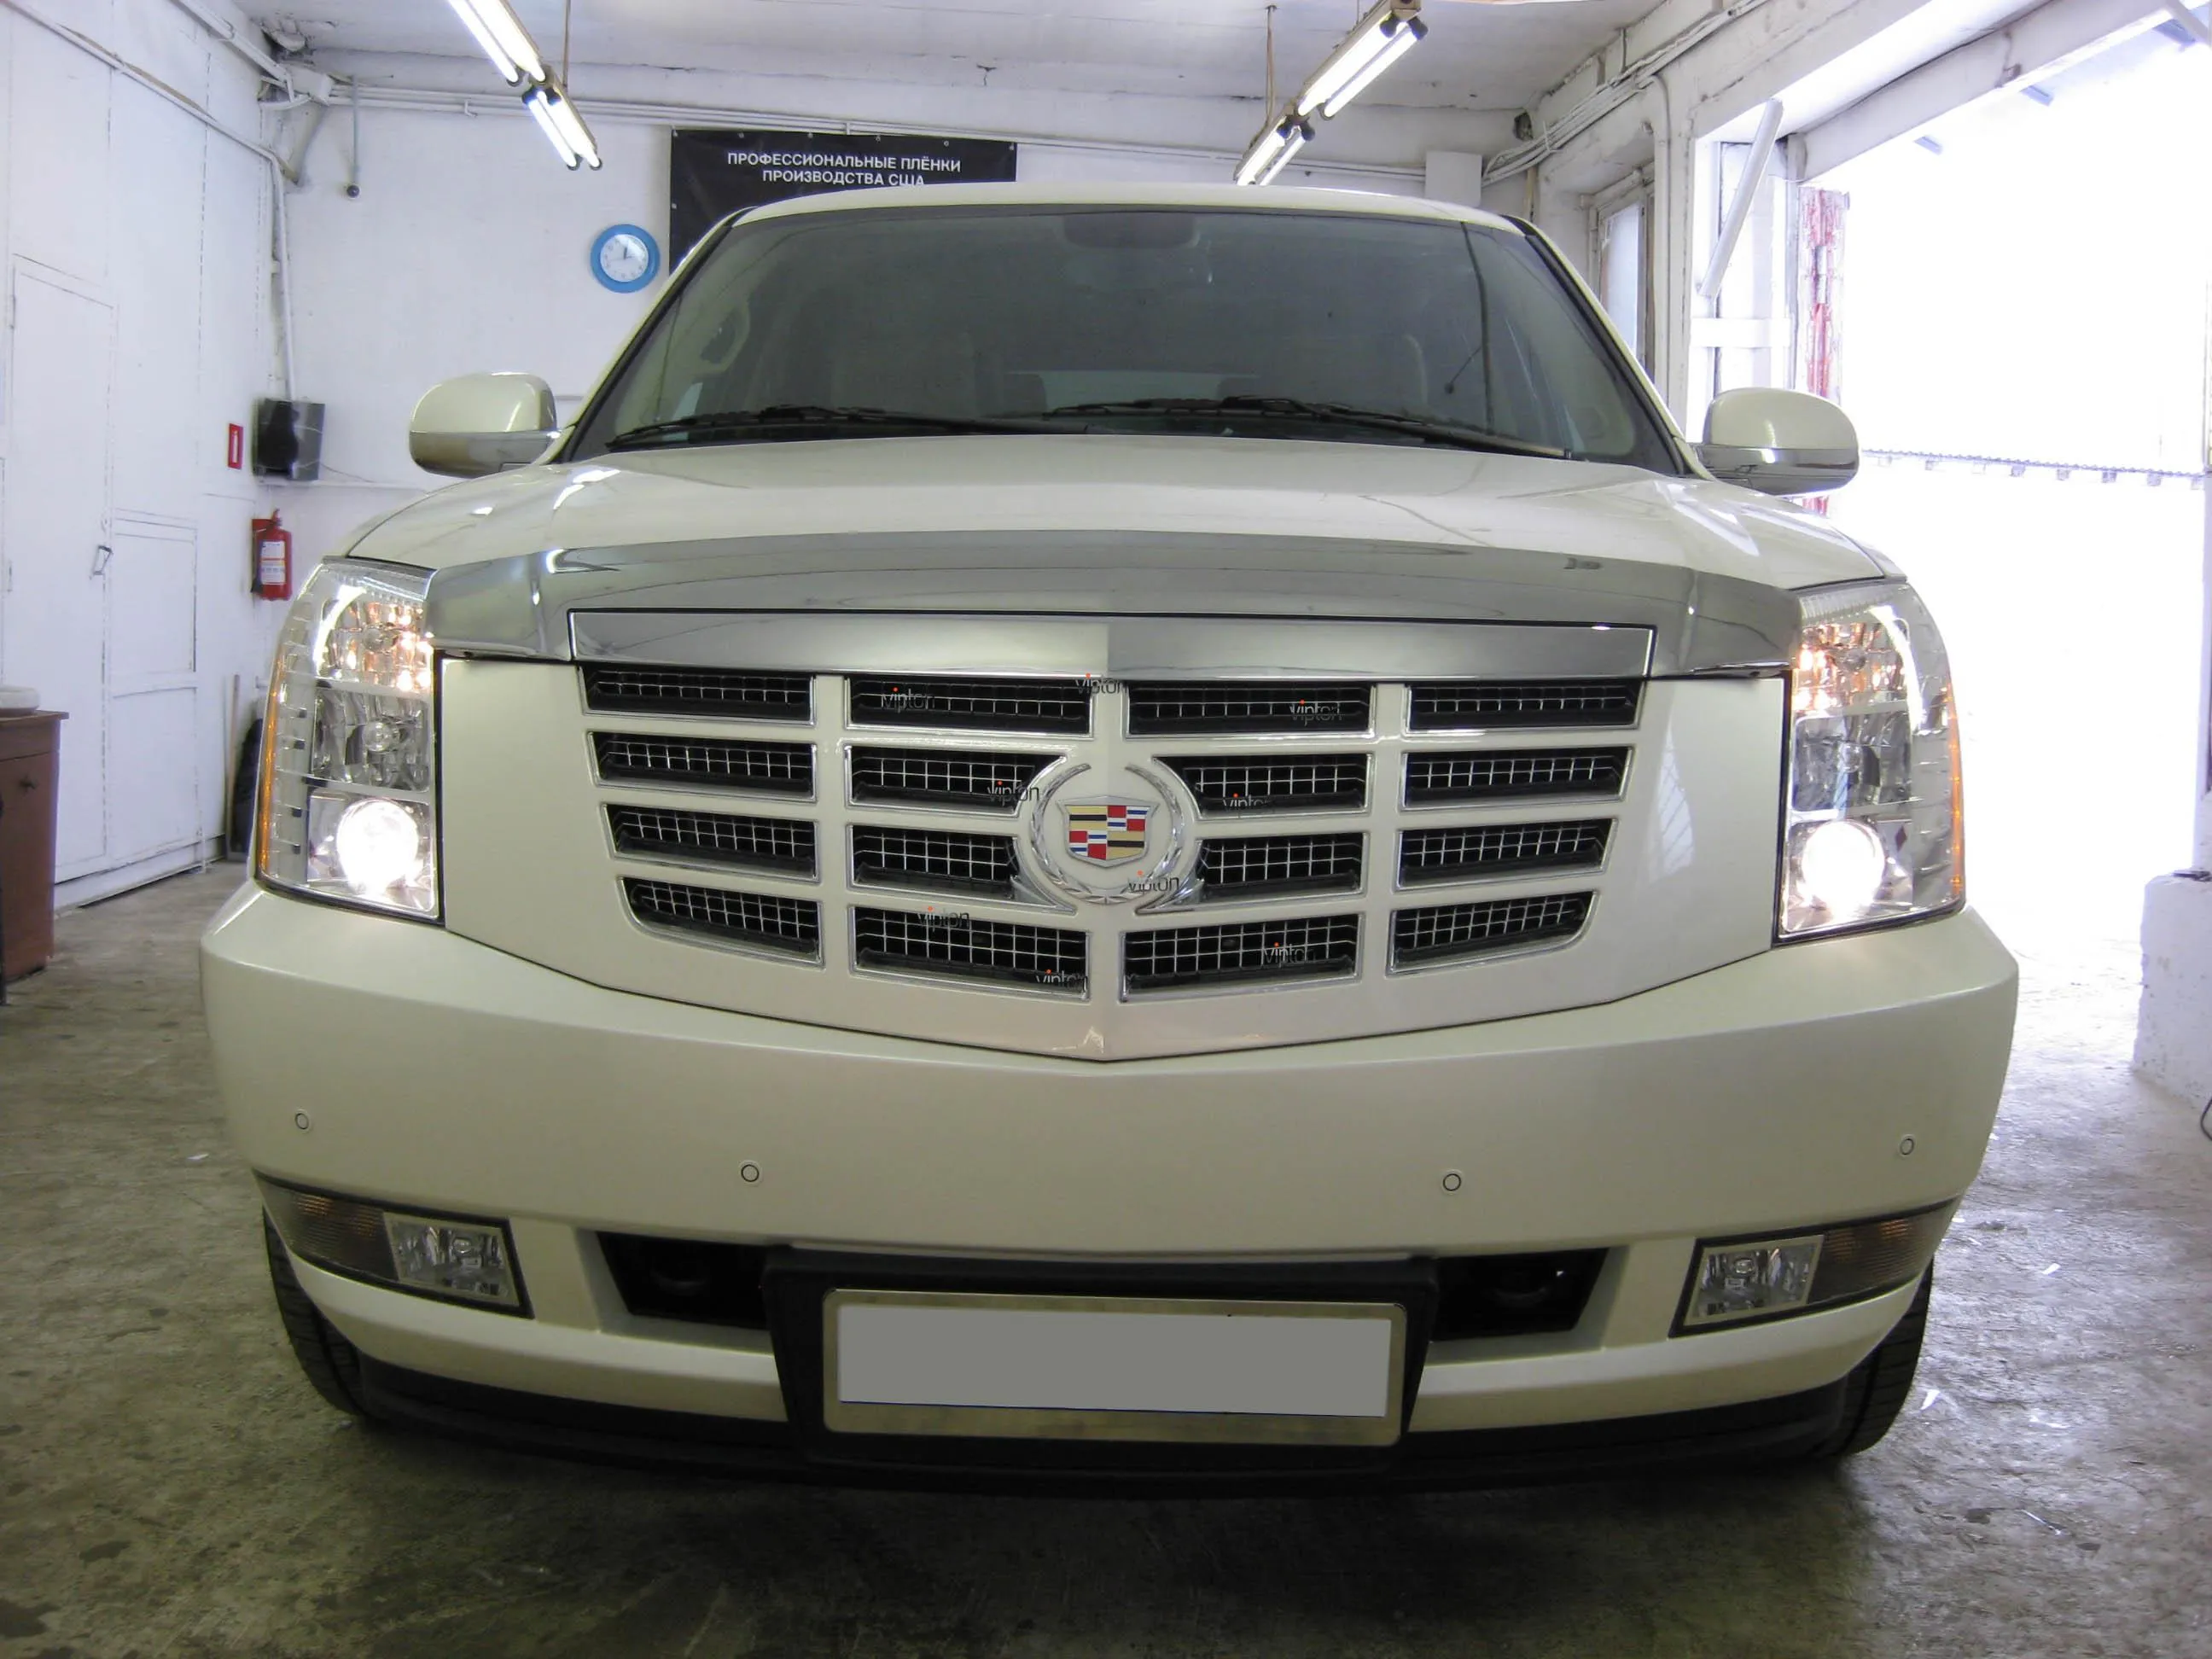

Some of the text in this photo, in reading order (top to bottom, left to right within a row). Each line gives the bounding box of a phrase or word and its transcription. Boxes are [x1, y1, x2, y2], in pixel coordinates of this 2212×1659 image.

[727, 152, 962, 172] ПРОФЕССИОНАЛЬНЫЕ ПЛЁНКИ
[762, 170, 924, 186] ПРОИЗВОДСТВА США
